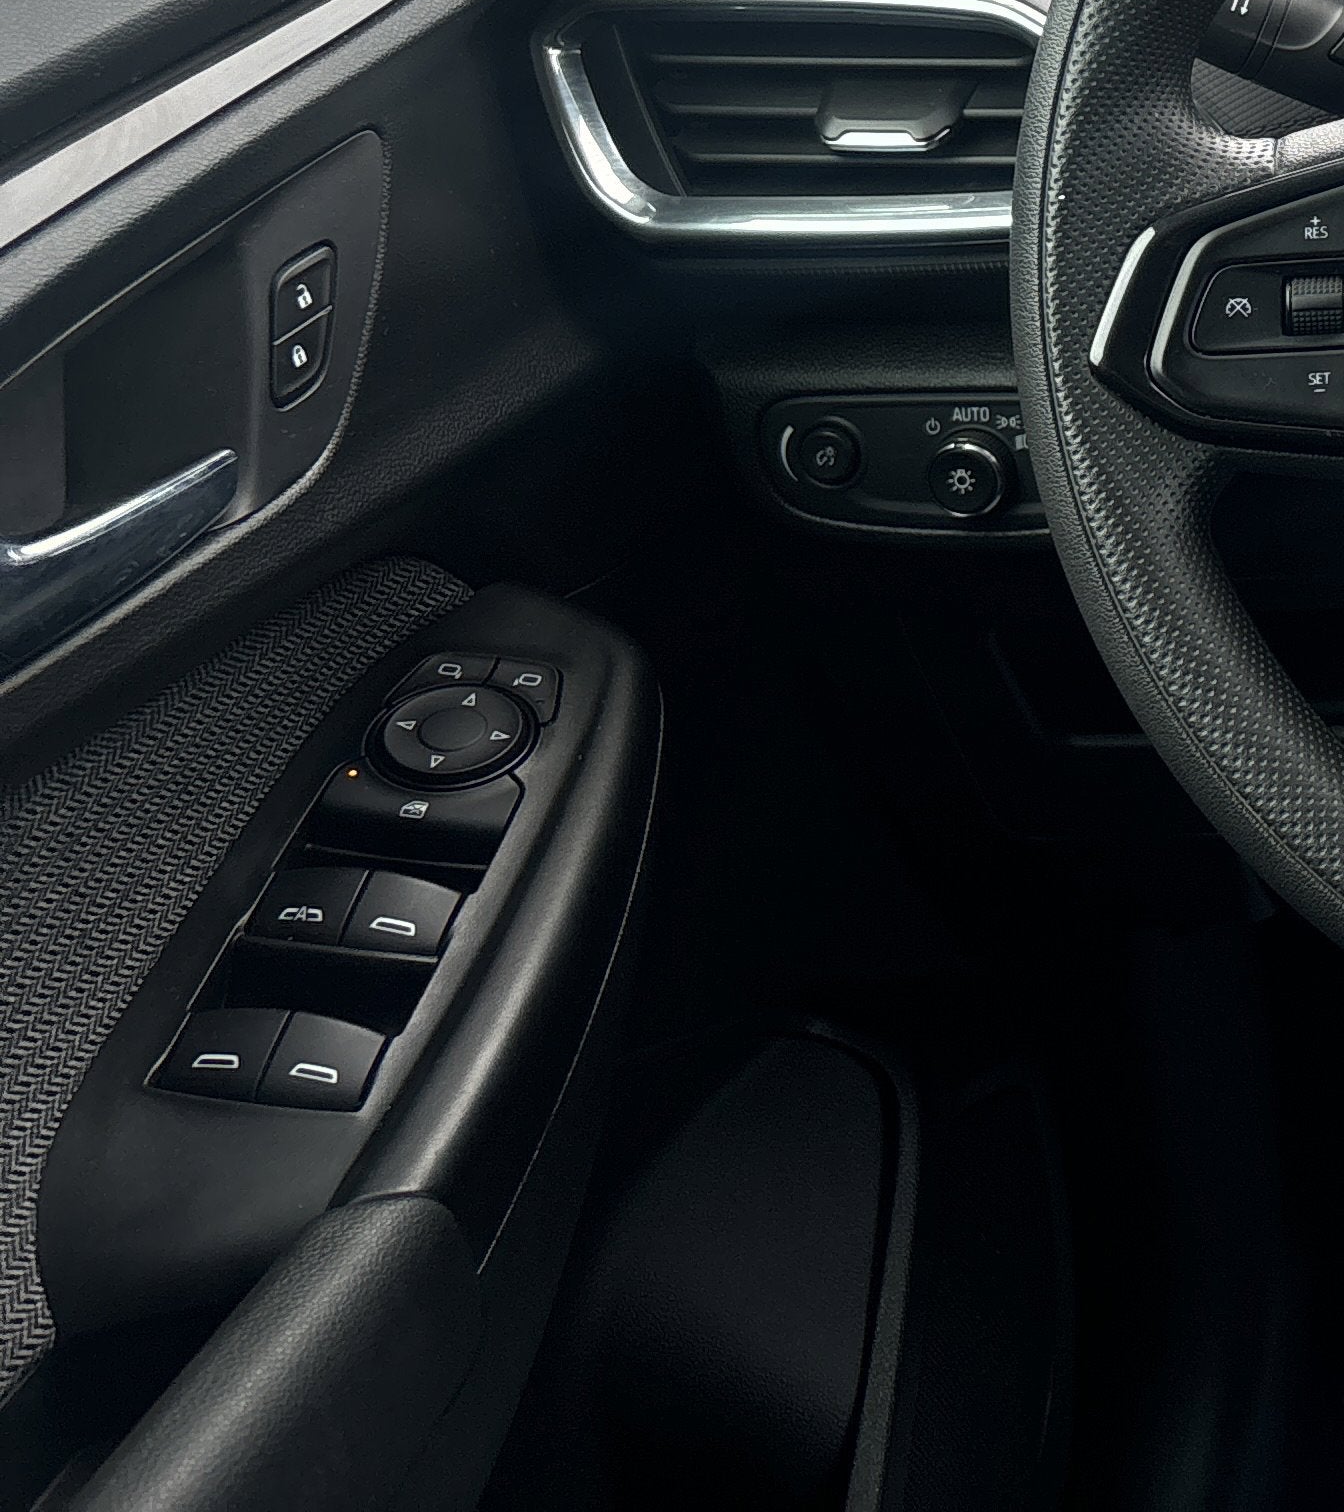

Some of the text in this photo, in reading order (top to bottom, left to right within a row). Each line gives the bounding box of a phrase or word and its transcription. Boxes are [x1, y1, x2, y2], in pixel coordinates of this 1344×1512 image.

[1303, 226, 1329, 240] RES
[1307, 371, 1331, 386] SET
[952, 406, 990, 423] AUTO
